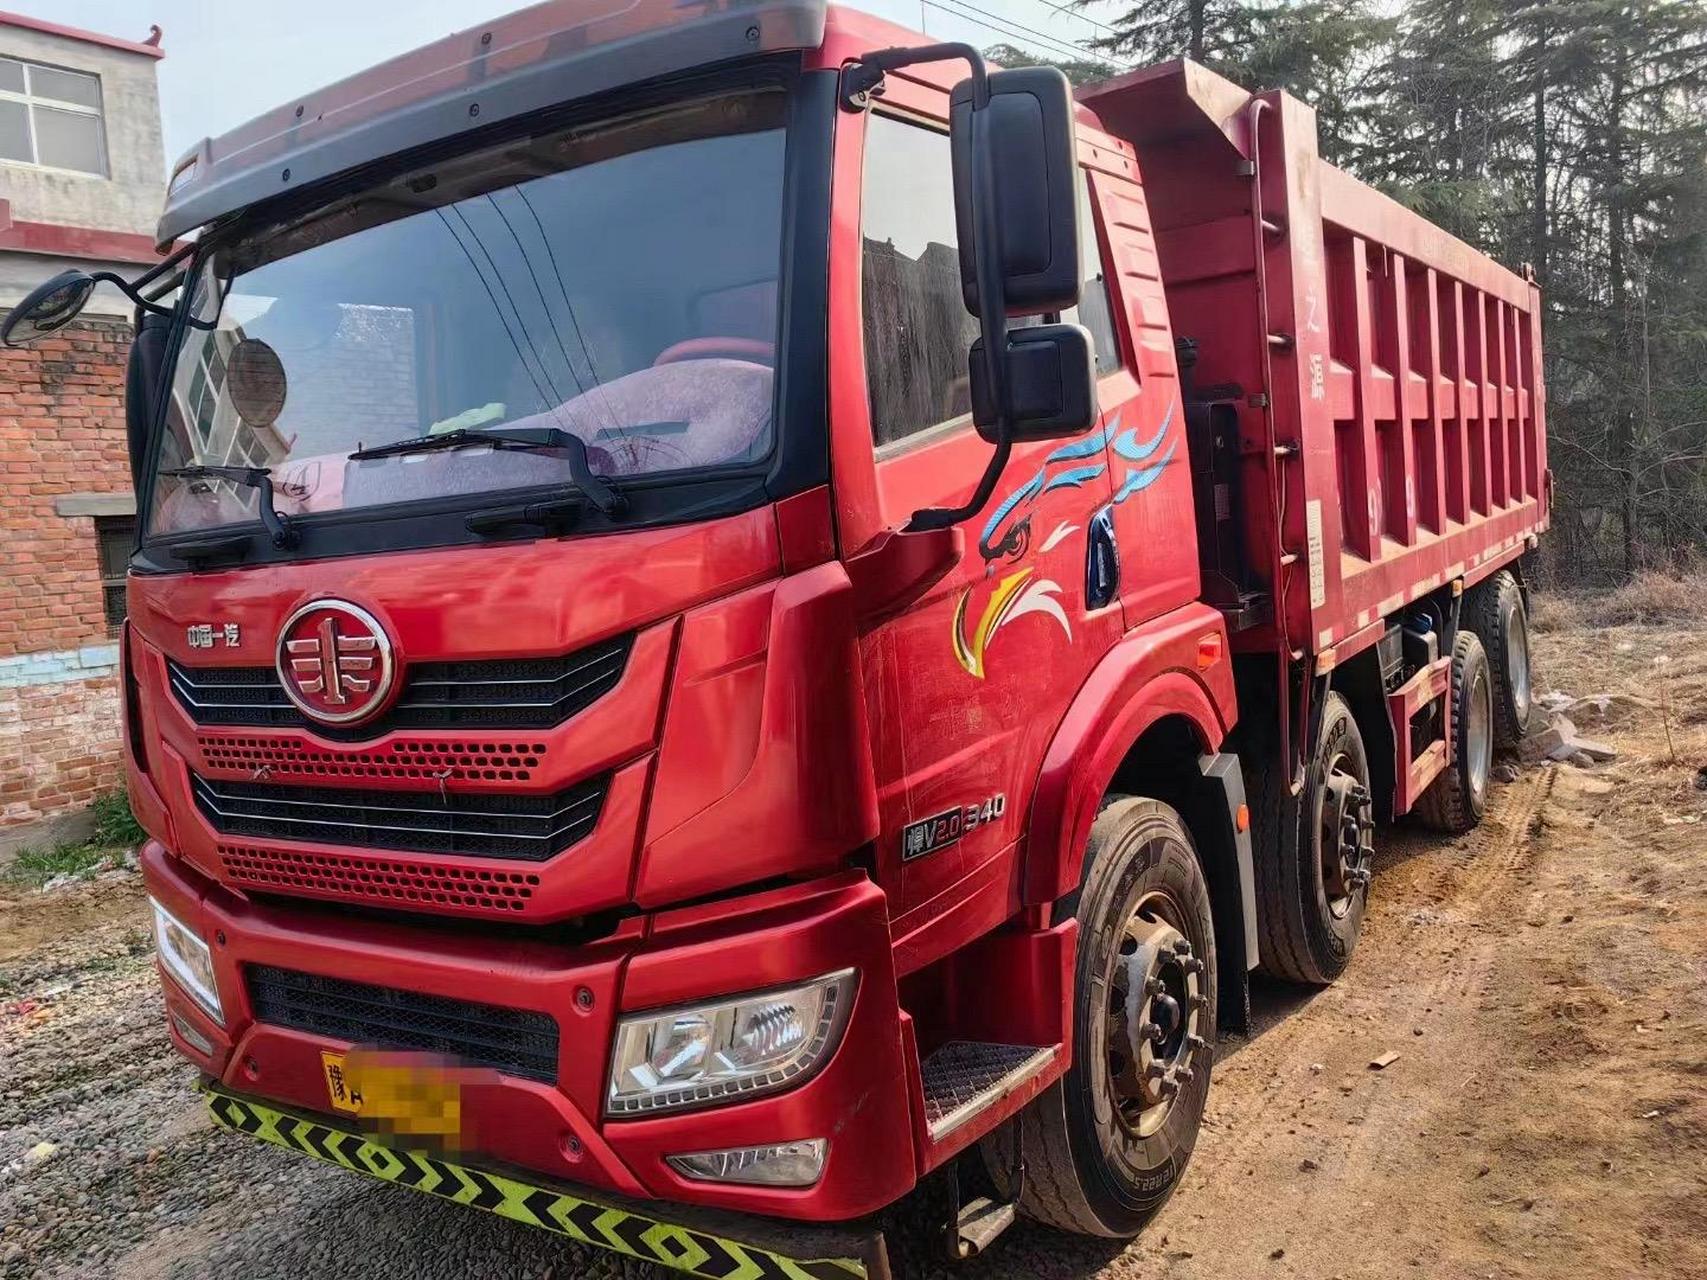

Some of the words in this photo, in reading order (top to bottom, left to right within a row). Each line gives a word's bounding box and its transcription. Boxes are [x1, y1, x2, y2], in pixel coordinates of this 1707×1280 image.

[187, 623, 240, 648] 中国一汽
[965, 793, 1005, 832] 340
